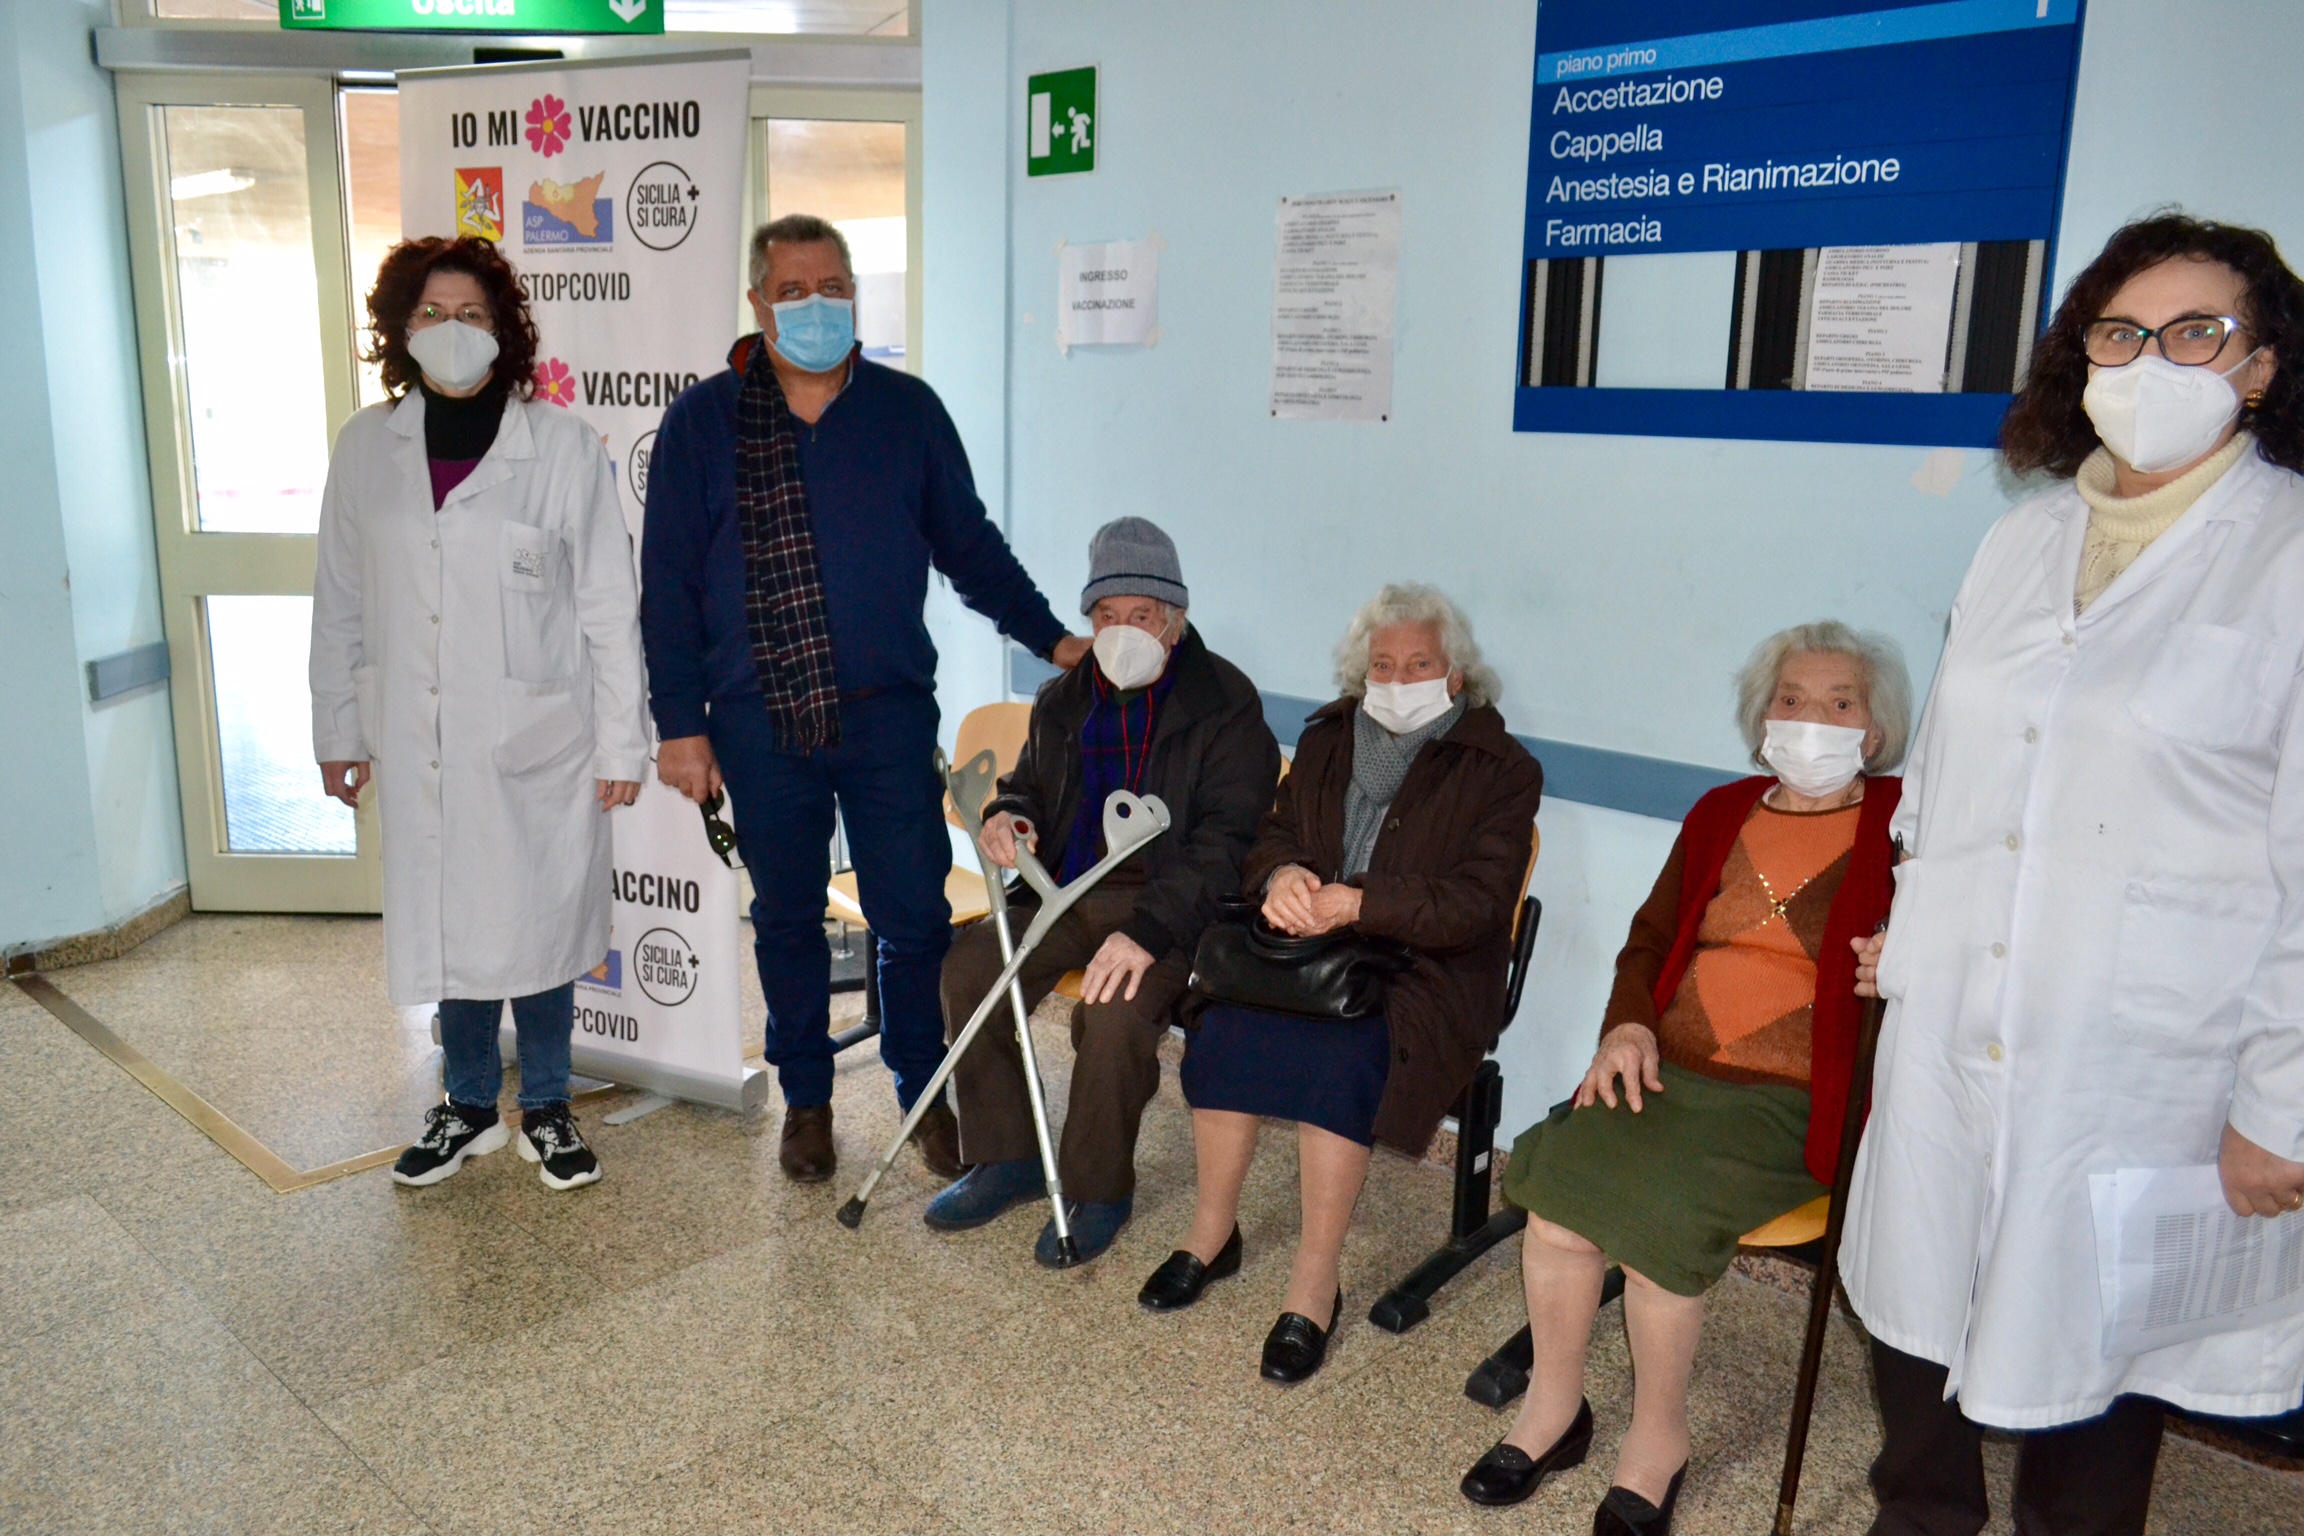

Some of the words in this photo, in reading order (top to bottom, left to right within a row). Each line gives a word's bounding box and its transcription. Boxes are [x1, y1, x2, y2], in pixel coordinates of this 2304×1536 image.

[413, 0, 515, 16] Uscita
[1557, 55, 1602, 79] piano
[1607, 48, 1656, 72] primo
[1552, 75, 1724, 115] Accettazione
[452, 112, 477, 148] IO
[488, 110, 518, 146] MI
[579, 100, 700, 142] VACCINO
[1550, 124, 1663, 163] Cappella
[1546, 168, 1670, 203] Anestesia
[1678, 172, 1695, 195] e
[1703, 154, 1900, 193] Rianimazione
[637, 184, 680, 205] SICILIA
[526, 216, 544, 228] ASP
[637, 207, 650, 228] SI
[653, 206, 687, 227] CURA
[526, 230, 568, 241] PALERMO
[1546, 214, 1662, 247] Farmacia
[1080, 269, 1128, 282] INGRESSO
[1072, 298, 1134, 311] VACCINAZIONE
[612, 868, 700, 913] ACCINO
[642, 944, 682, 968] SICILIA
[642, 964, 654, 982] SI
[656, 966, 688, 989] CURA
[574, 1006, 638, 1042] PCOVID
